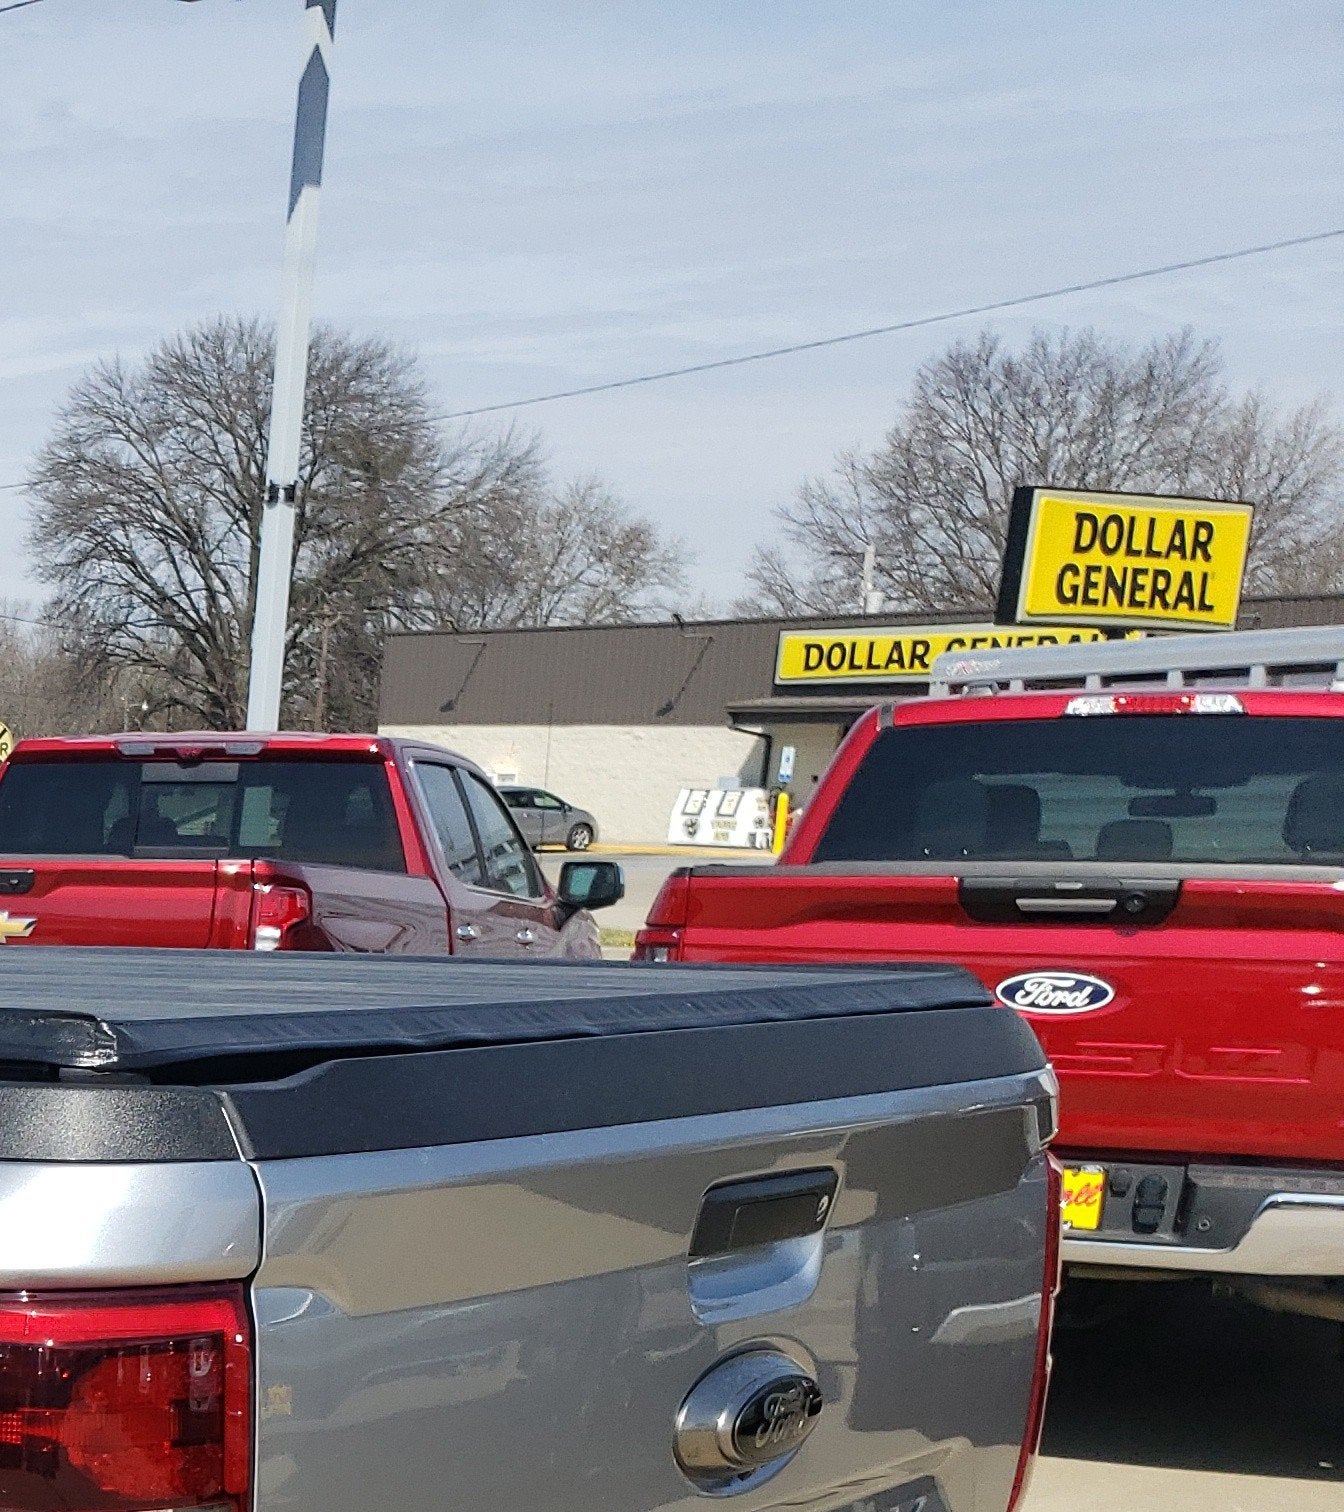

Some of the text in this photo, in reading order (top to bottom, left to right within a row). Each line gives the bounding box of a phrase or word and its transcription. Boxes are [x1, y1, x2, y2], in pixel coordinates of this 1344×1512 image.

[1073, 511, 1215, 563] DOLLAR
[1056, 563, 1216, 612] GENERAL
[803, 640, 931, 672] DOLLAR
[1014, 977, 1094, 1007] Ford
[1063, 1183, 1103, 1207] all
